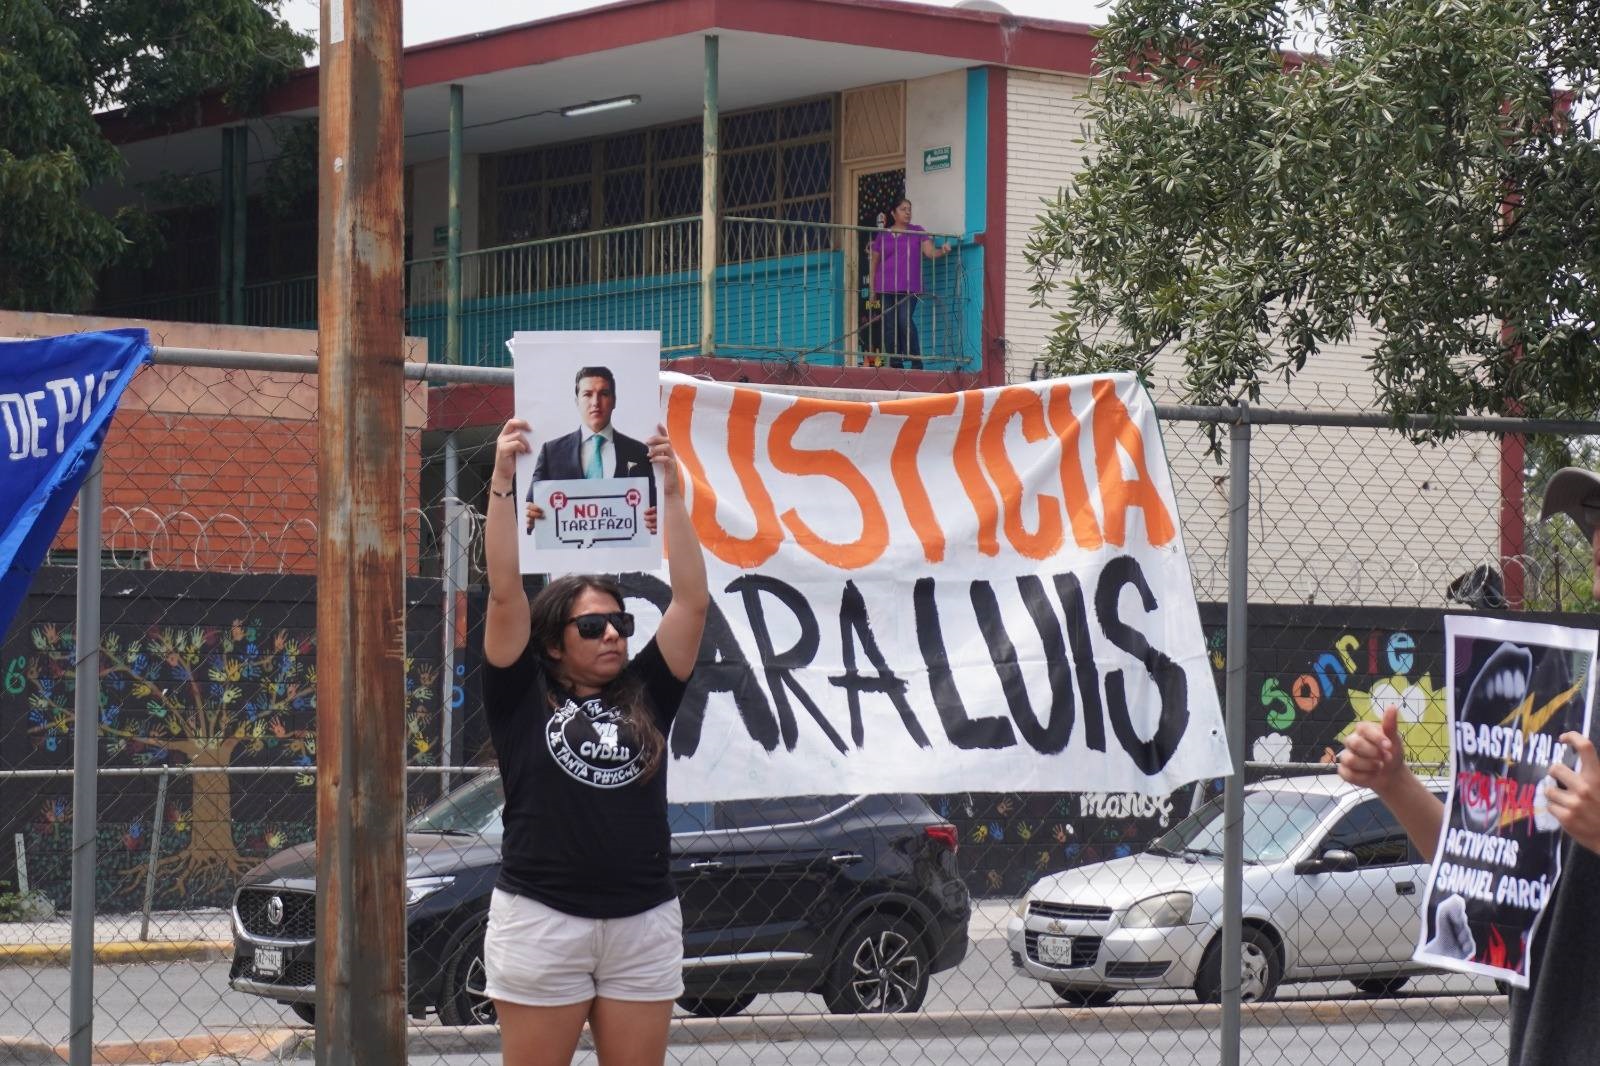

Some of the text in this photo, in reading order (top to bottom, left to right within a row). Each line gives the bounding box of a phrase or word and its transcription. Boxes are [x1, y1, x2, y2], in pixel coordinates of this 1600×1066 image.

[0, 391, 48, 460] DE
[660, 377, 1176, 571] USTICIA
[561, 517, 633, 532] TARIFAZO
[574, 503, 617, 519] NO AL
[913, 554, 1189, 776] LUIS
[1445, 827, 1520, 869] ACTIVISTAS
[1436, 862, 1494, 903] SAMUEL
